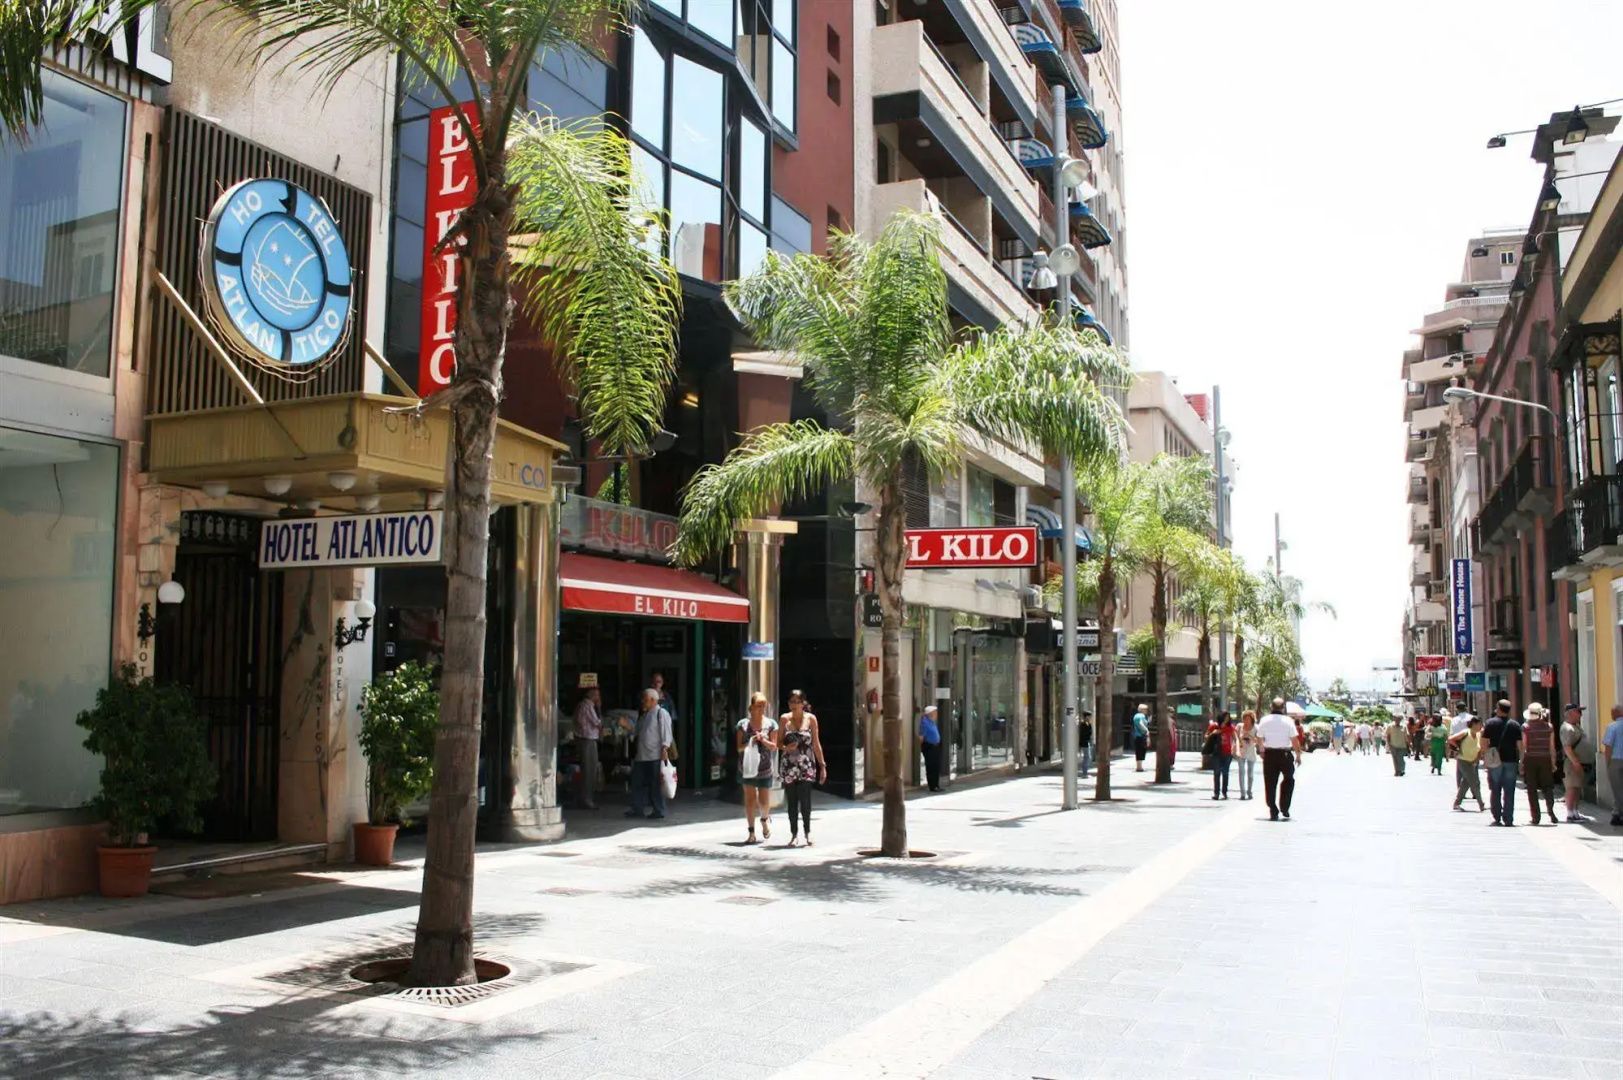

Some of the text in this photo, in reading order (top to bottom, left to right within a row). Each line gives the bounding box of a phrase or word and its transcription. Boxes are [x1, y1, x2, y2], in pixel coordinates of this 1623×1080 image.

[439, 114, 471, 196] EL
[264, 514, 434, 563] HOTEL ATLANTICO
[905, 533, 1029, 561] L KILO
[635, 596, 698, 617] EL KILO
[1456, 561, 1466, 632] The Phone House
